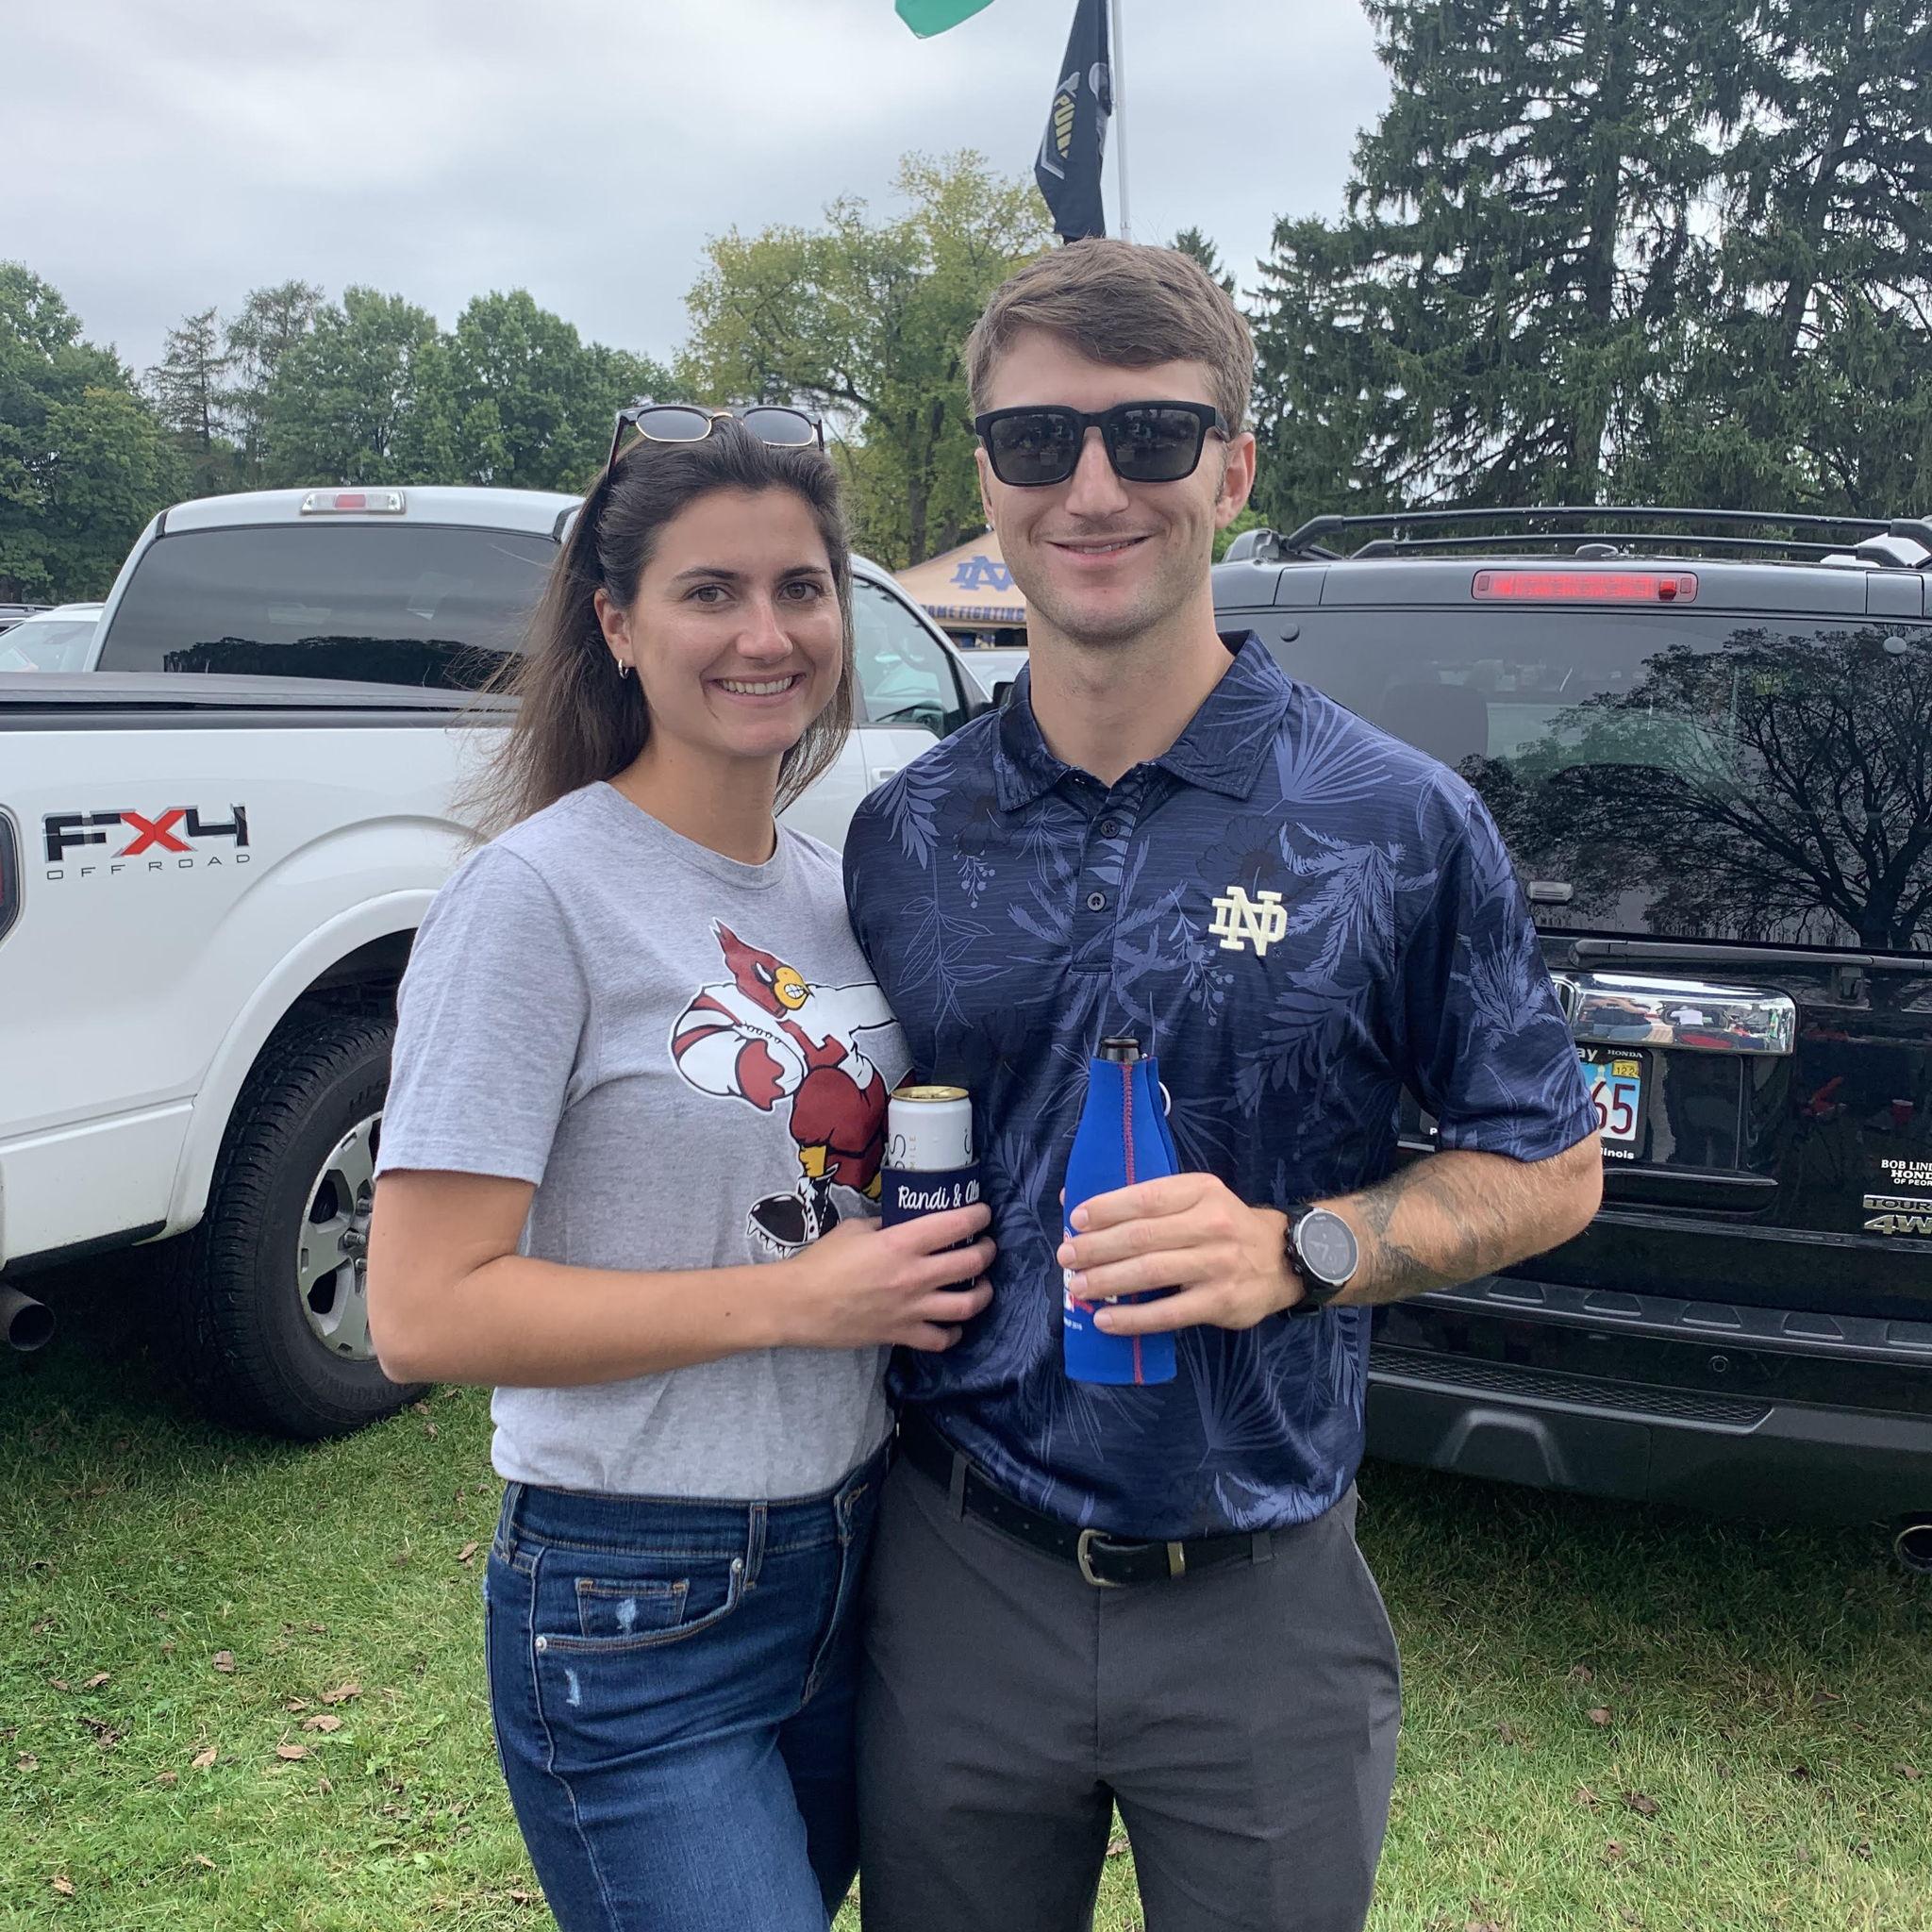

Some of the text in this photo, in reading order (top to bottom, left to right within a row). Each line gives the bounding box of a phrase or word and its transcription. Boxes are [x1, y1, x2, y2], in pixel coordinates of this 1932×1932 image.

[42, 803, 250, 863] FX4
[1208, 886, 1288, 957] ND
[1607, 1049, 1643, 1058] HONDA
[1591, 1080, 1636, 1135] 65
[1881, 1159, 1906, 1170] BOB
[1890, 1170, 1932, 1180] HOND
[898, 1185, 950, 1210] Randi
[953, 1183, 962, 1208] &
[1865, 1196, 1932, 1211] TOUR
